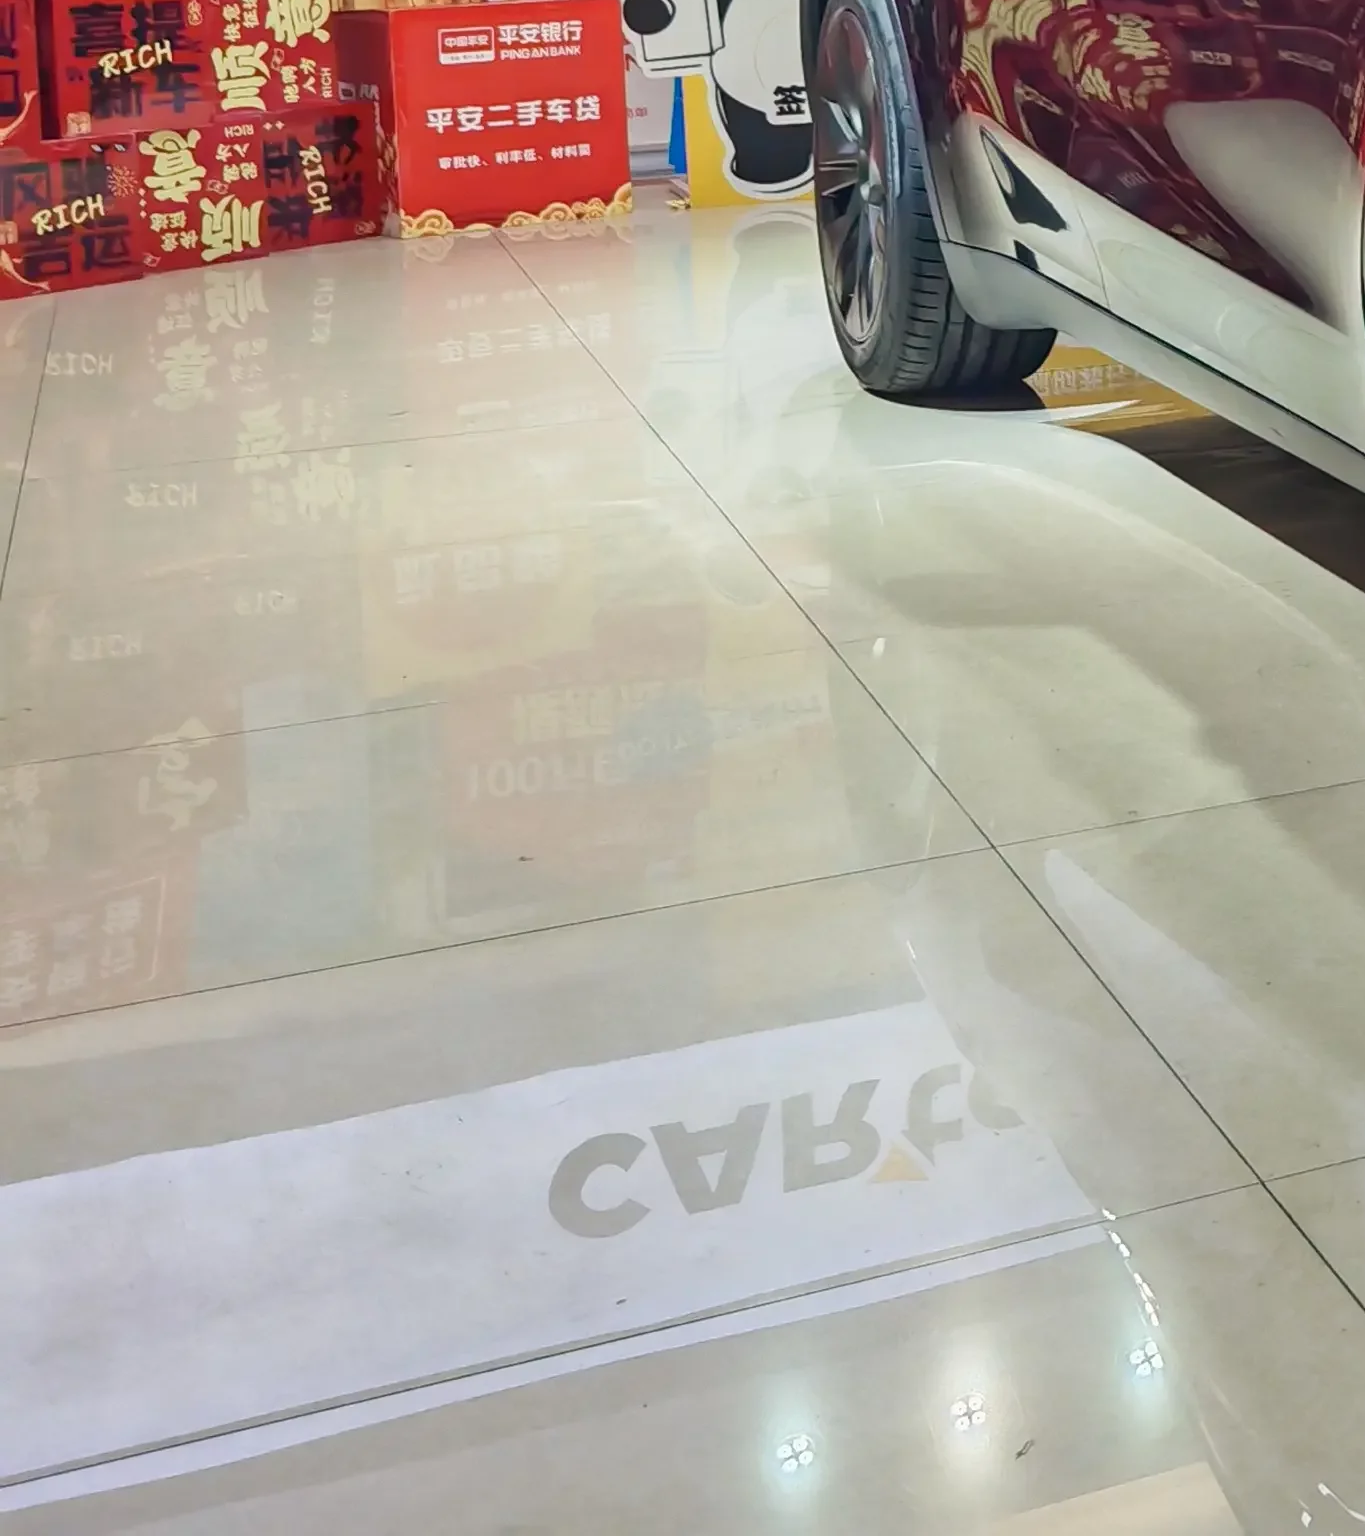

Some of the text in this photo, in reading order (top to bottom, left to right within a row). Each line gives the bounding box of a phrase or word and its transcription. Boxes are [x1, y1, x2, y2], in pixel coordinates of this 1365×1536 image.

[497, 19, 583, 45] 平安银行
[98, 38, 173, 79] RICH
[549, 44, 582, 57] BANK
[319, 67, 333, 99] RICH
[223, 123, 255, 139] RICH
[425, 95, 602, 135] 平安二手车贷
[298, 144, 334, 215] RICH
[31, 193, 106, 236] RICH
